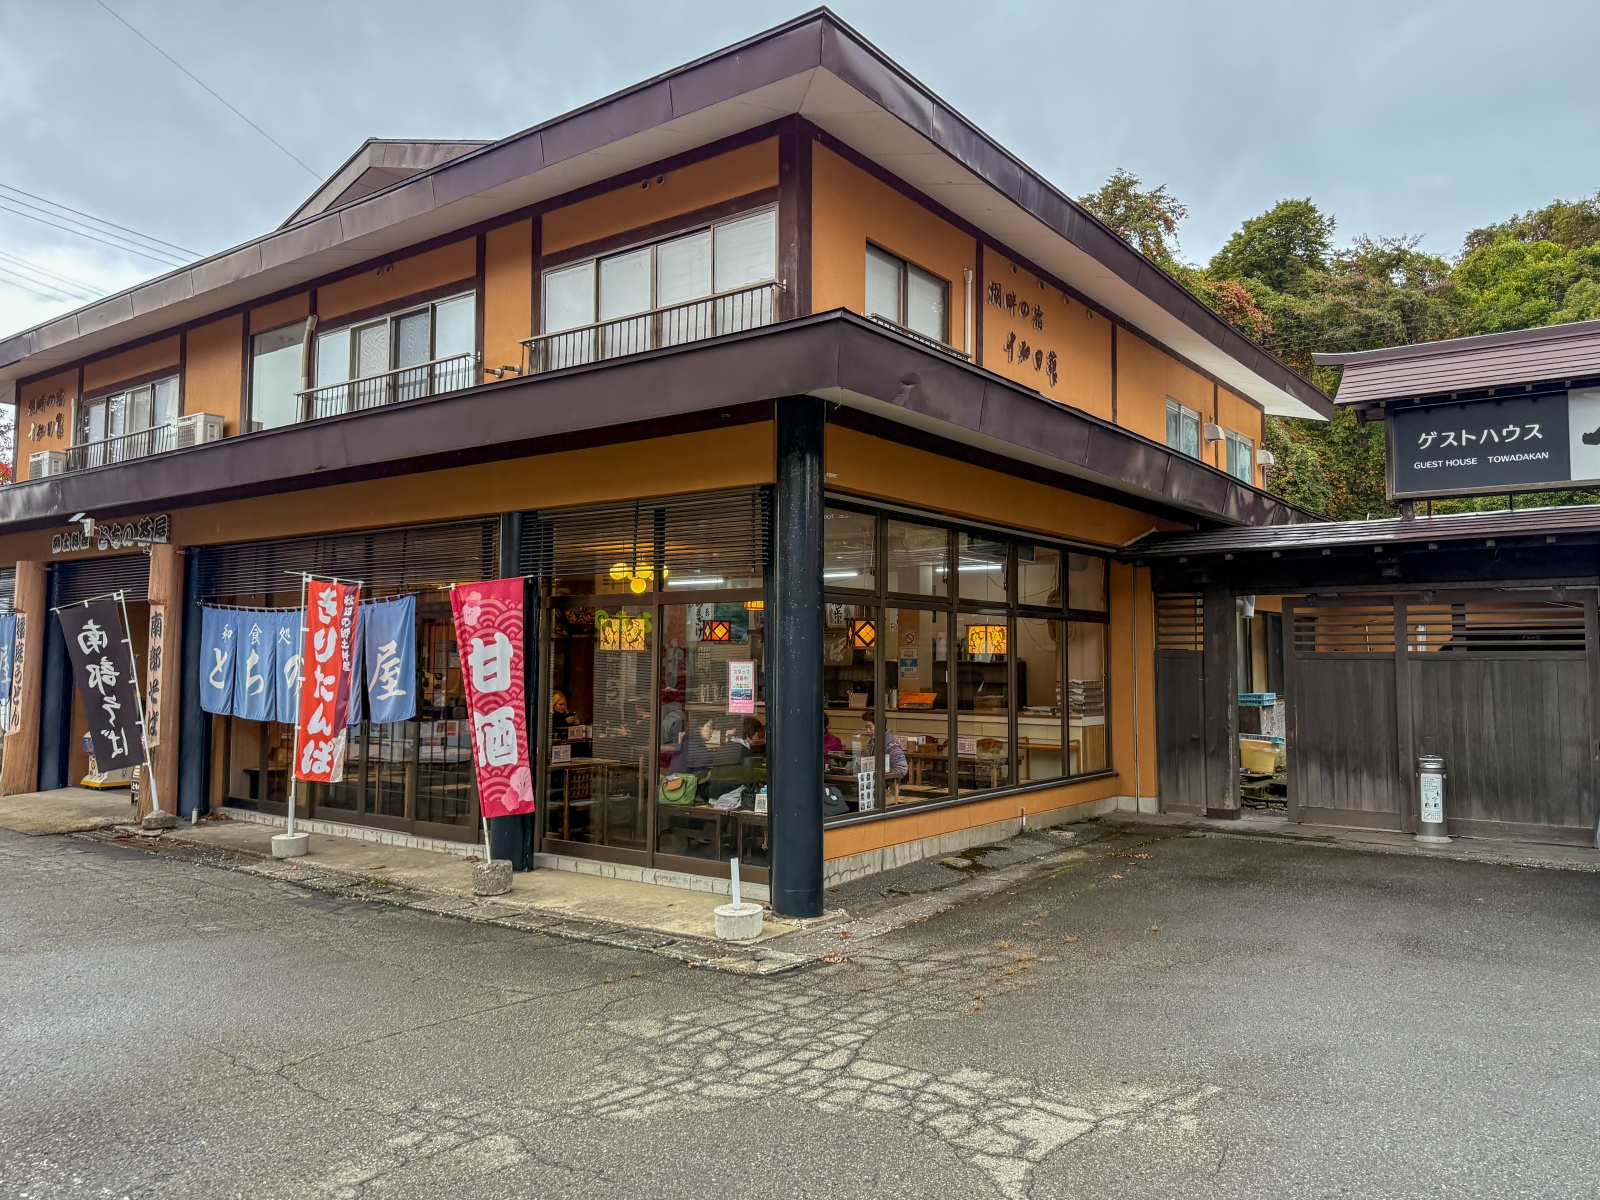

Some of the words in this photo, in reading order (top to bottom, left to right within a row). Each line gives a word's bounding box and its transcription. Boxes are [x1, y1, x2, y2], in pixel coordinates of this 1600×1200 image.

[1413, 460, 1443, 470] GUEST
[1445, 457, 1478, 467] HOUSE
[1487, 451, 1549, 464] TOWADAKAN
[1418, 424, 1543, 450] ゲストハウス
[221, 622, 291, 646] 和食処
[149, 611, 163, 736] 南部そば
[301, 587, 337, 774] きりたんぽ
[468, 631, 518, 767] 甘酒
